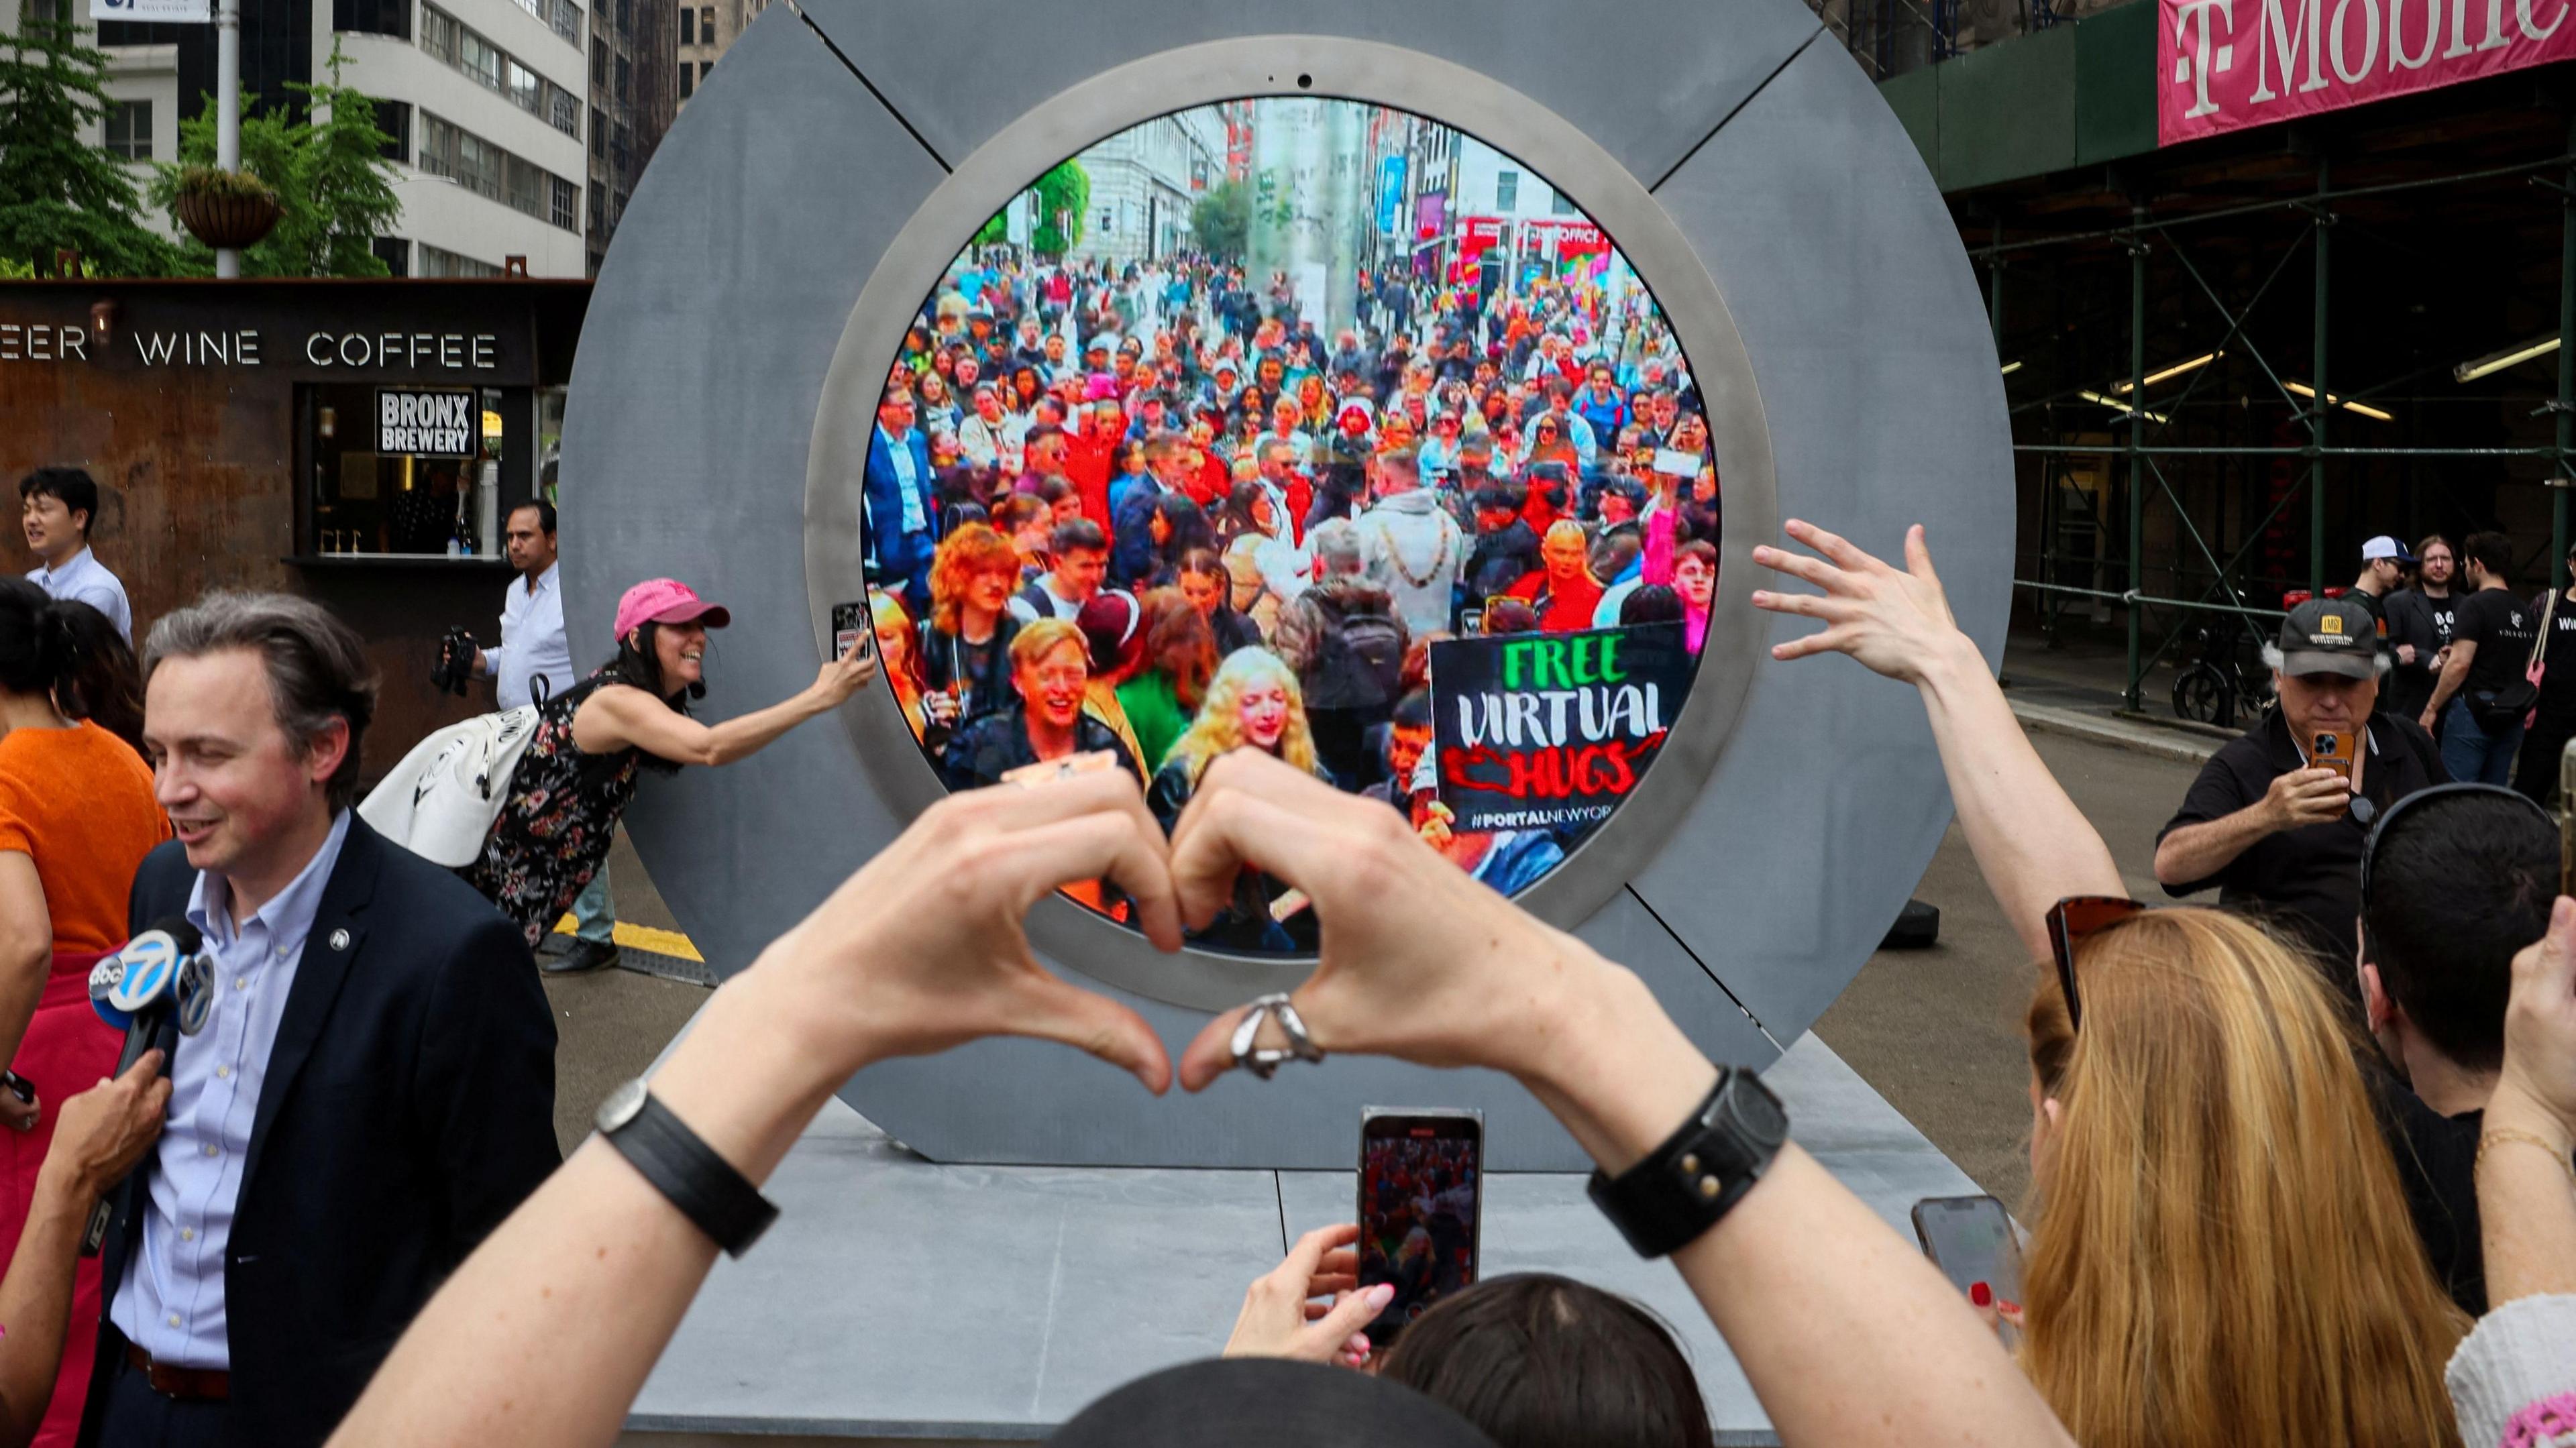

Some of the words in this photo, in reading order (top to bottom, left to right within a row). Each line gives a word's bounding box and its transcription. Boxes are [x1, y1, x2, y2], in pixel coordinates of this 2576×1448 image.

[135, 331, 260, 366] WINE
[307, 331, 496, 369] COFFEE
[382, 394, 469, 429] BRONX
[382, 428, 469, 453] BREWERY
[1503, 634, 1627, 691] FREE
[1458, 683, 1668, 748] VIRTUAL
[1508, 741, 1635, 797] HUGS
[1472, 805, 1614, 829] #PORTALNEWYOR
[89, 963, 123, 986] abc
[109, 930, 176, 1012] 7
